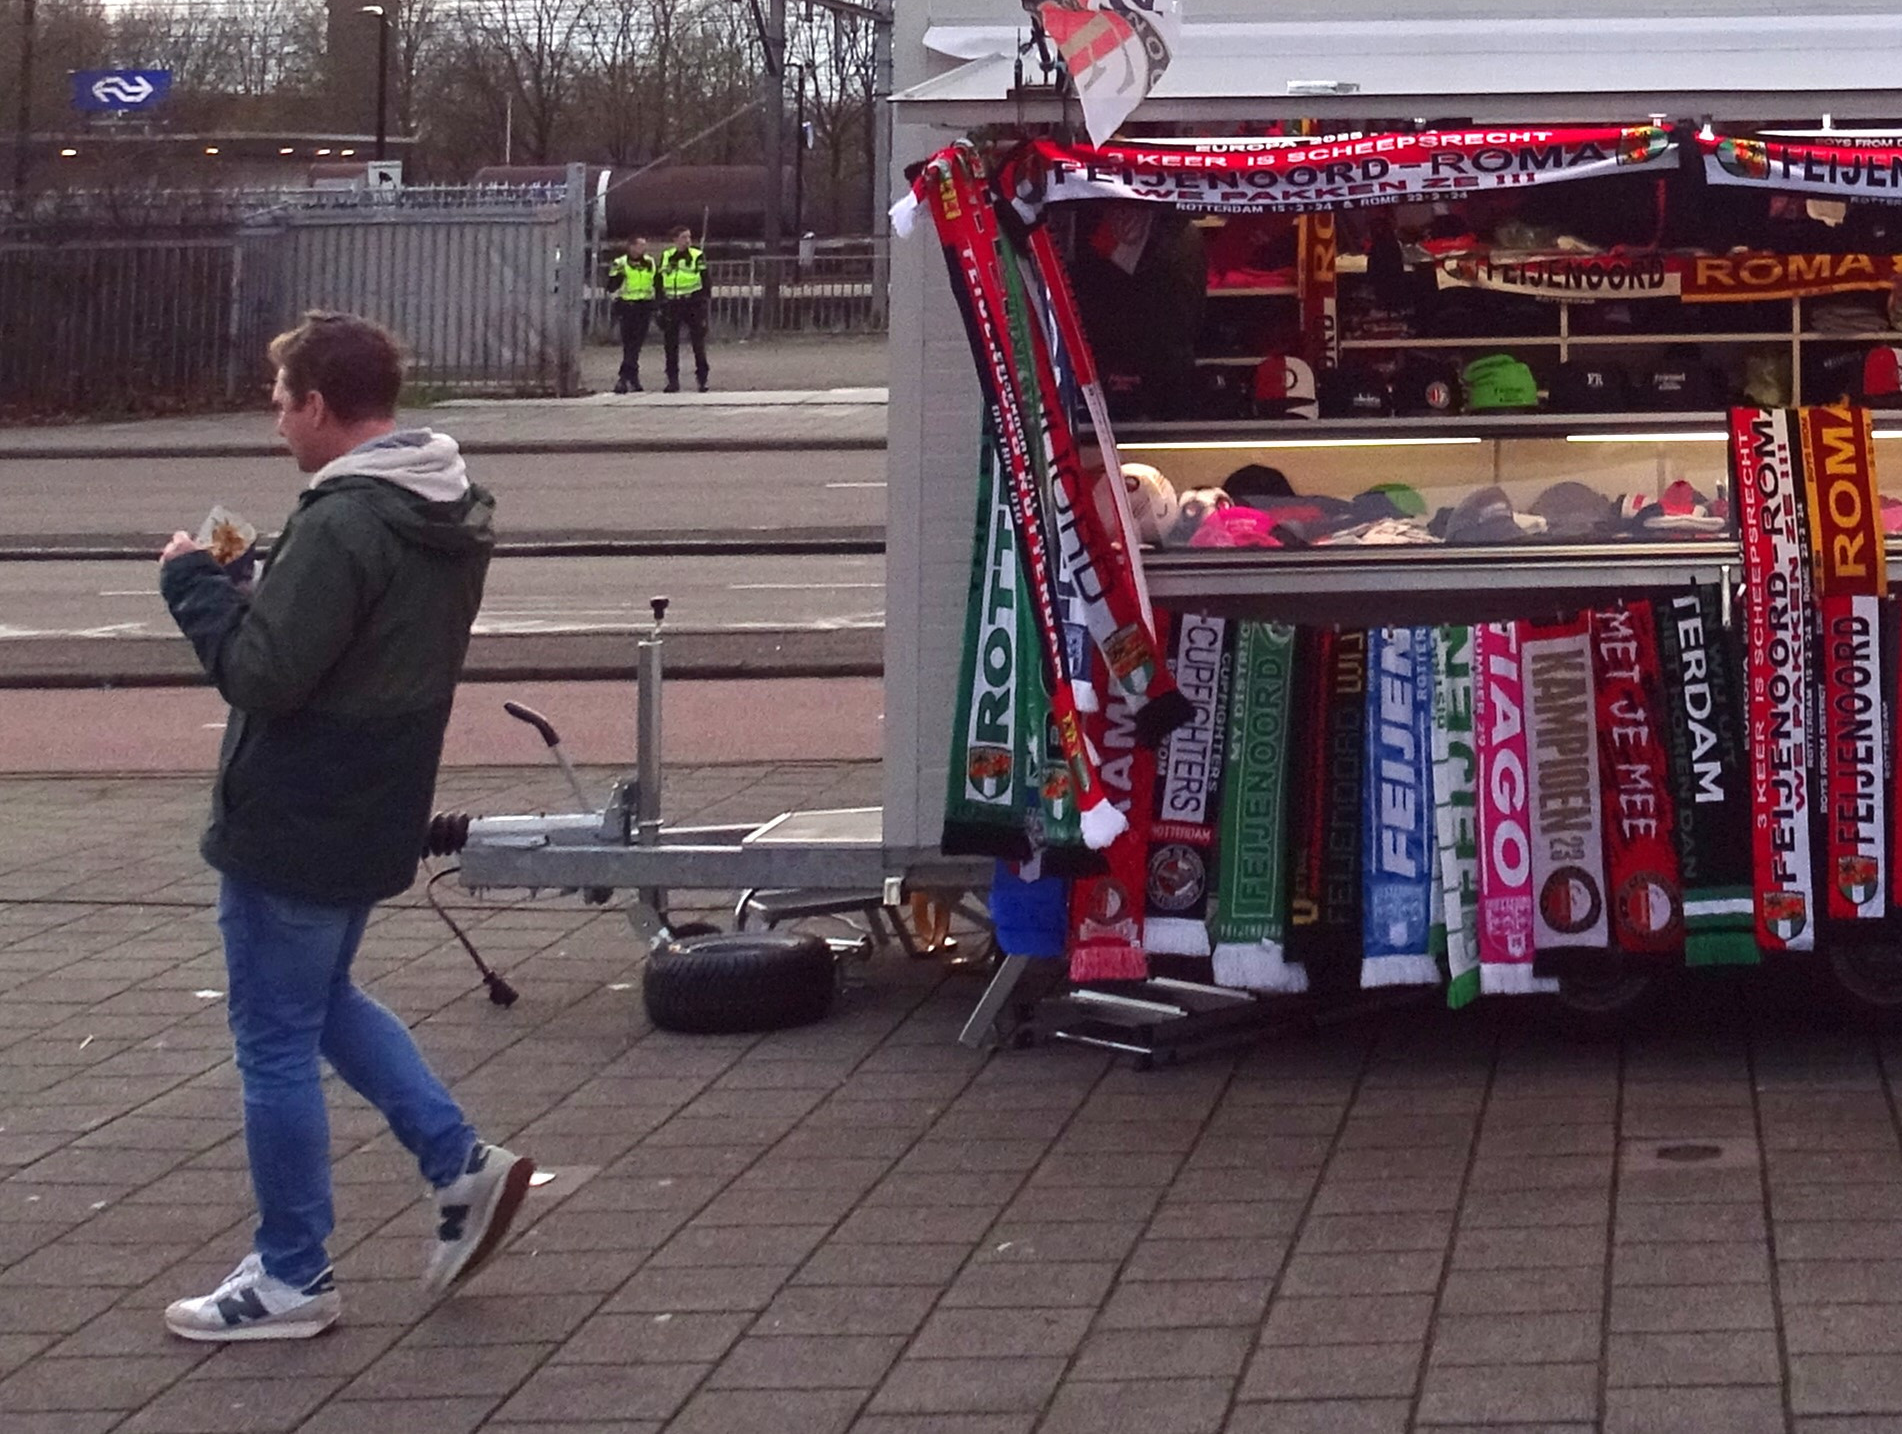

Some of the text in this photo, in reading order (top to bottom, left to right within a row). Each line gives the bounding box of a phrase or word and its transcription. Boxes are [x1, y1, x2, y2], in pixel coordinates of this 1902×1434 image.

[1136, 153, 1228, 168] KEER
[1246, 154, 1276, 168] IS
[1286, 130, 1553, 162] SCHEEPSRECHT
[1855, 137, 1895, 149] FROM
[1130, 186, 1205, 202] WE
[1219, 180, 1407, 203] PAKKEN
[1421, 175, 1480, 189] ZE
[1175, 202, 1264, 214] ROTTERDAM
[1696, 253, 1877, 286] ROMA
[1784, 494, 1798, 544] ZE
[1737, 432, 1765, 666] SCHEEPSRECHT
[1786, 556, 1803, 728] PAKKEN
[1754, 680, 1765, 702] IS
[1817, 683, 1827, 736] DISTRICT
[1208, 652, 1233, 794] CUPFIGHTERS
[1229, 727, 1242, 762] MY
[1595, 609, 1659, 841] MET JE MEE
[1833, 615, 1876, 846] FEIJENOORD
[1530, 647, 1594, 863] KAMPIOEN 23
[1754, 719, 1769, 804] KEER
[1790, 750, 1806, 812] WE
[1818, 738, 1828, 775] FROM
[1239, 655, 1284, 911] FEIJENOORD
